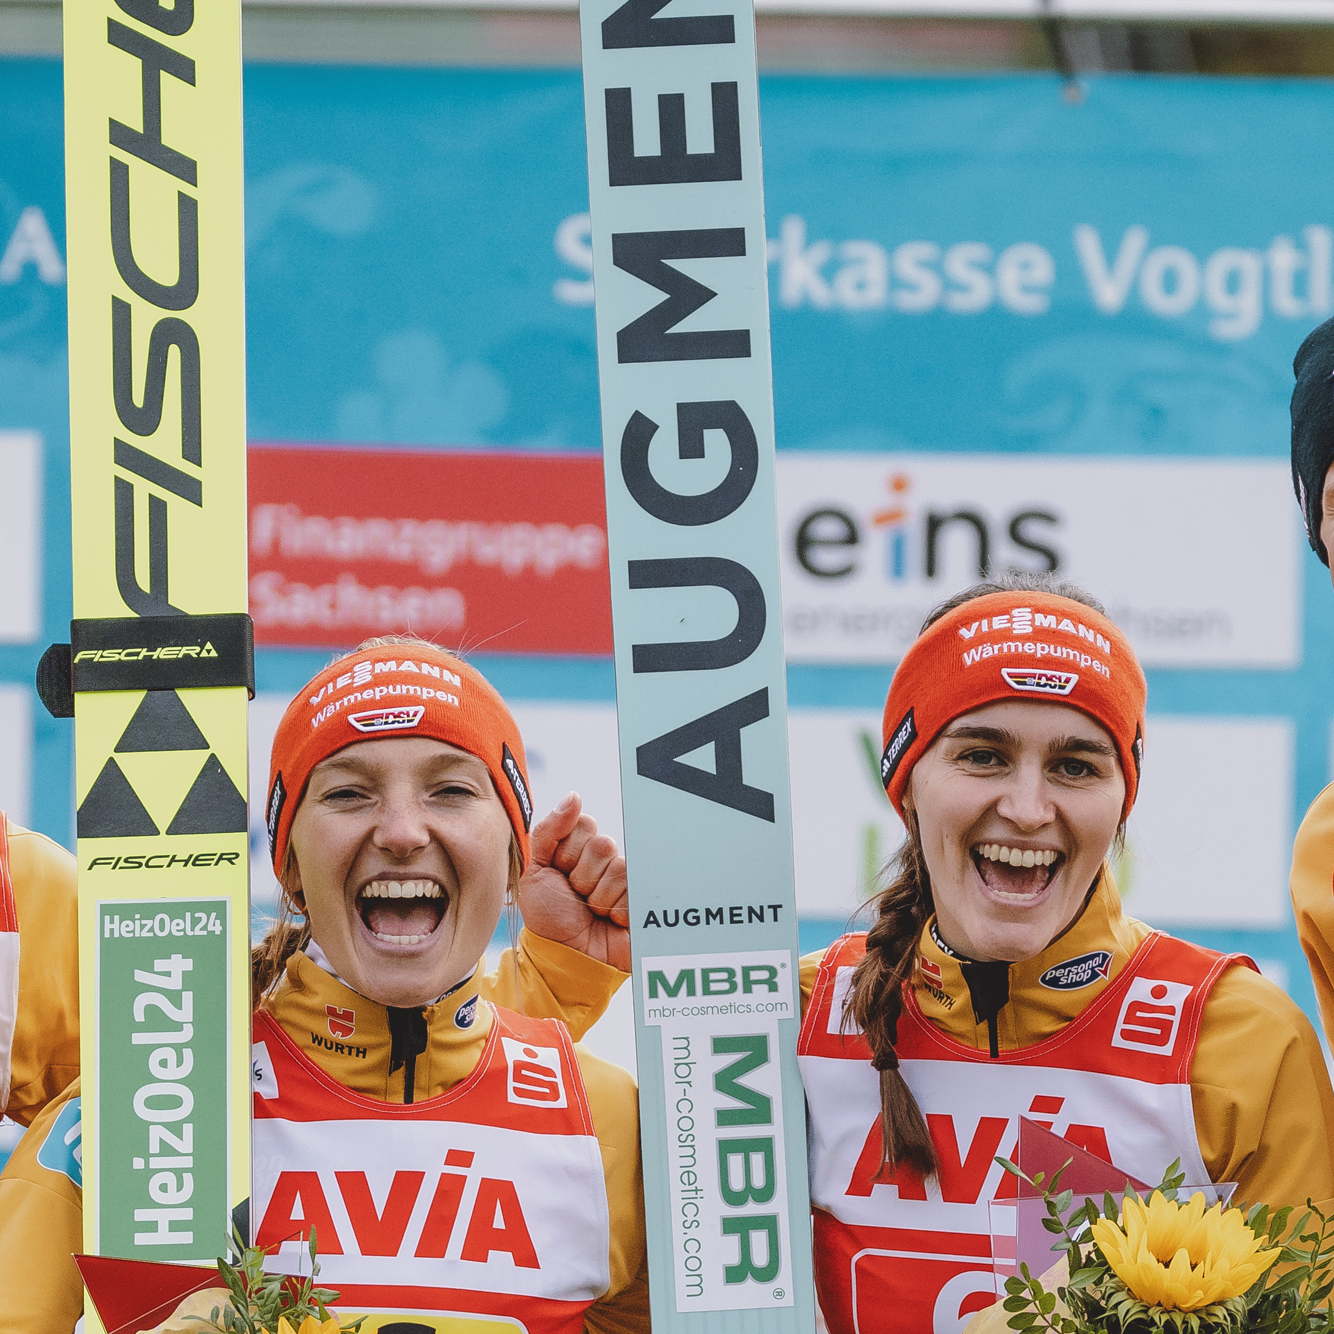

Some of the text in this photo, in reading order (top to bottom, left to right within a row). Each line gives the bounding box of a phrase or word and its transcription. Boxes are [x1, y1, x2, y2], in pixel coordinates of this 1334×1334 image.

[107, 0, 203, 617] FISCH
[250, 503, 605, 568] Finanzgruppe
[793, 474, 1062, 580] eins
[250, 570, 465, 630] Sachsen
[958, 607, 1112, 655] VIESSMANN
[73, 643, 201, 664] FISCHER
[963, 641, 1111, 679] Wärmepumpen
[308, 659, 462, 706] VIESSMANN
[1036, 672, 1069, 690] DSV
[310, 684, 460, 729] Wärmepumpen
[385, 709, 419, 726] DSV
[888, 717, 913, 766] TERREX
[86, 851, 240, 872] FISCHER
[642, 904, 784, 929] AUGMENT
[1045, 953, 1104, 982] personal
[1057, 968, 1092, 987] shop
[648, 1000, 789, 1019] mbr-cosmetics.com
[672, 1036, 704, 1299] mbr-cosmetics.com
